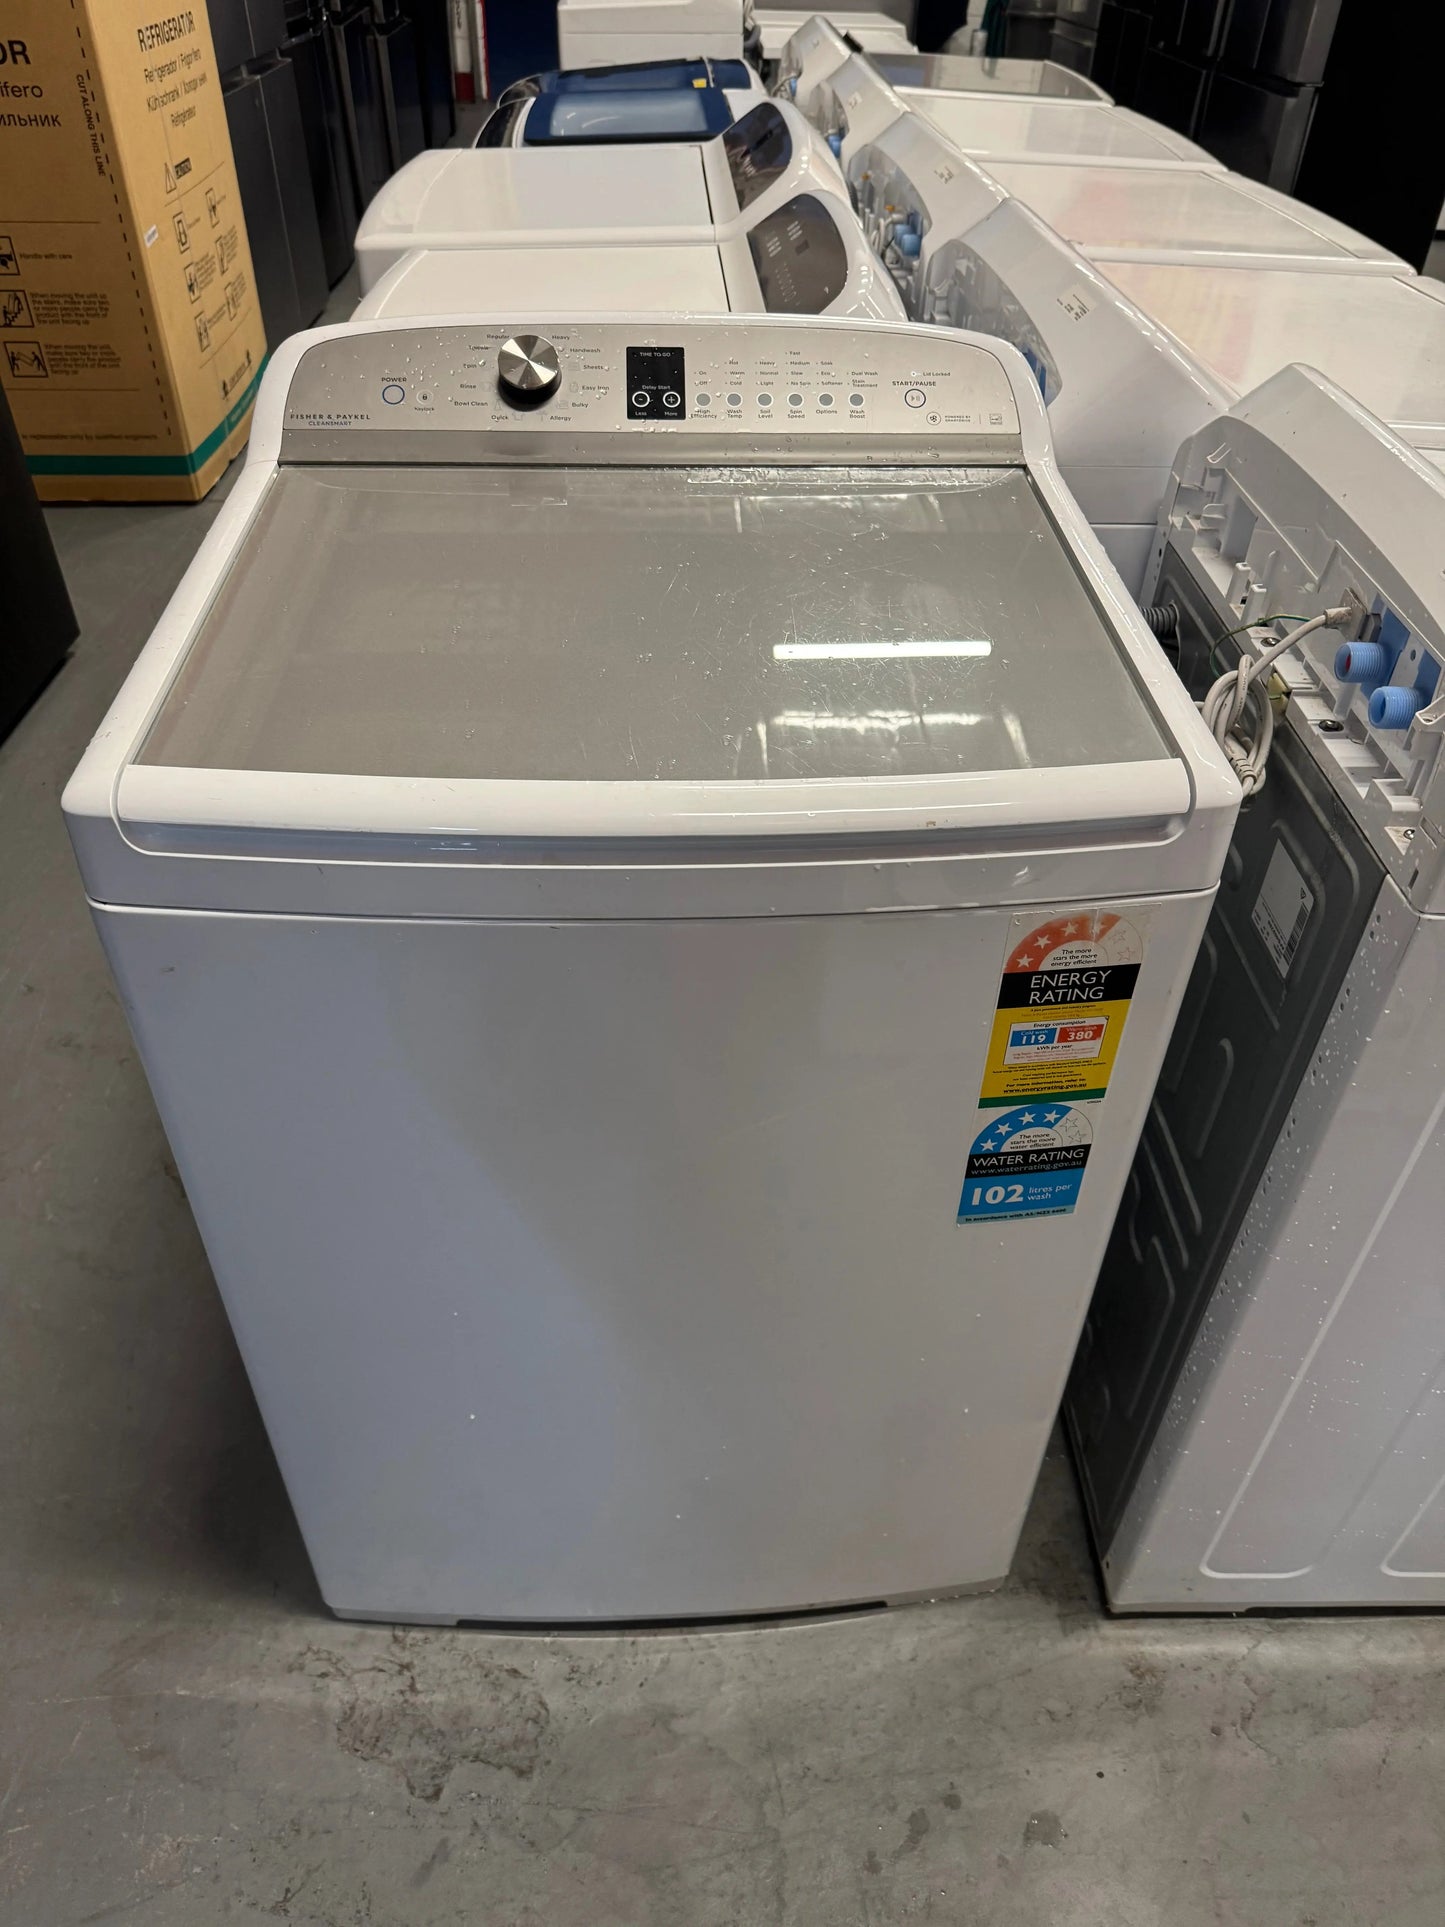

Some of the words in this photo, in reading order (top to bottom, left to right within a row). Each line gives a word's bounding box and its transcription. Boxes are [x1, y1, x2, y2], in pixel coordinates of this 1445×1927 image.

[137, 10, 196, 53] REFRIGERATOR
[76, 74, 87, 94] CUT
[81, 95, 95, 131] ALONG
[90, 132, 101, 154] THIS
[95, 155, 106, 177] LINE
[1030, 969, 1112, 989] ENERGY
[1029, 986, 1105, 1005] RATING
[1021, 1034, 1046, 1045] 119
[1067, 1030, 1094, 1041] 380
[1003, 1083, 1087, 1094] www.energyrating.gov.au
[973, 1154, 1024, 1167] WATER
[1028, 1148, 1085, 1163] RATING
[970, 1160, 1082, 1175] www.waterrating.gov.au
[971, 1184, 1024, 1206] 102
[1028, 1185, 1053, 1194] litres
[1055, 1183, 1073, 1193] per
[1027, 1192, 1052, 1201] wash
